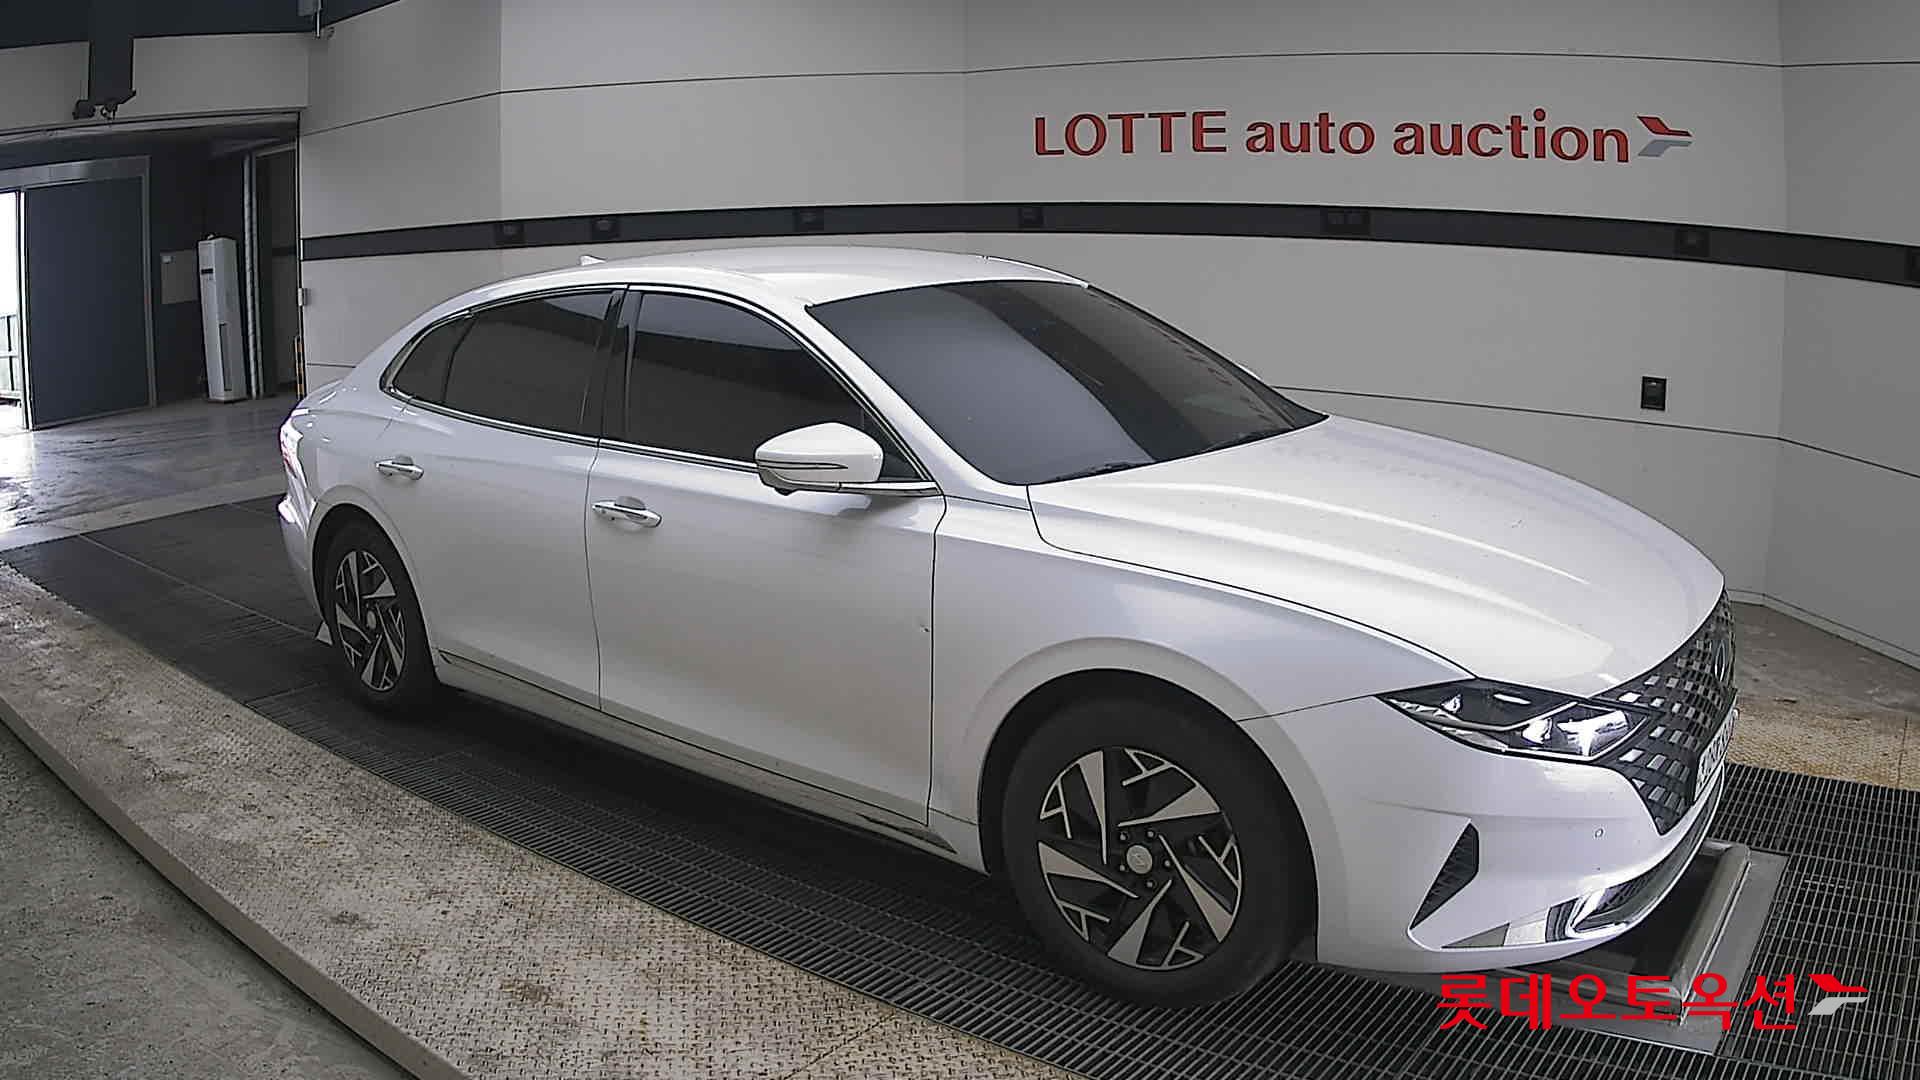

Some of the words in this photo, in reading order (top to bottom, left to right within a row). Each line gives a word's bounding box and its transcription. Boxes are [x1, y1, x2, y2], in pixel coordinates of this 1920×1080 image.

[1035, 111, 1227, 156] LOTTE
[1245, 112, 1375, 155] auto
[1393, 108, 1630, 163] auction
